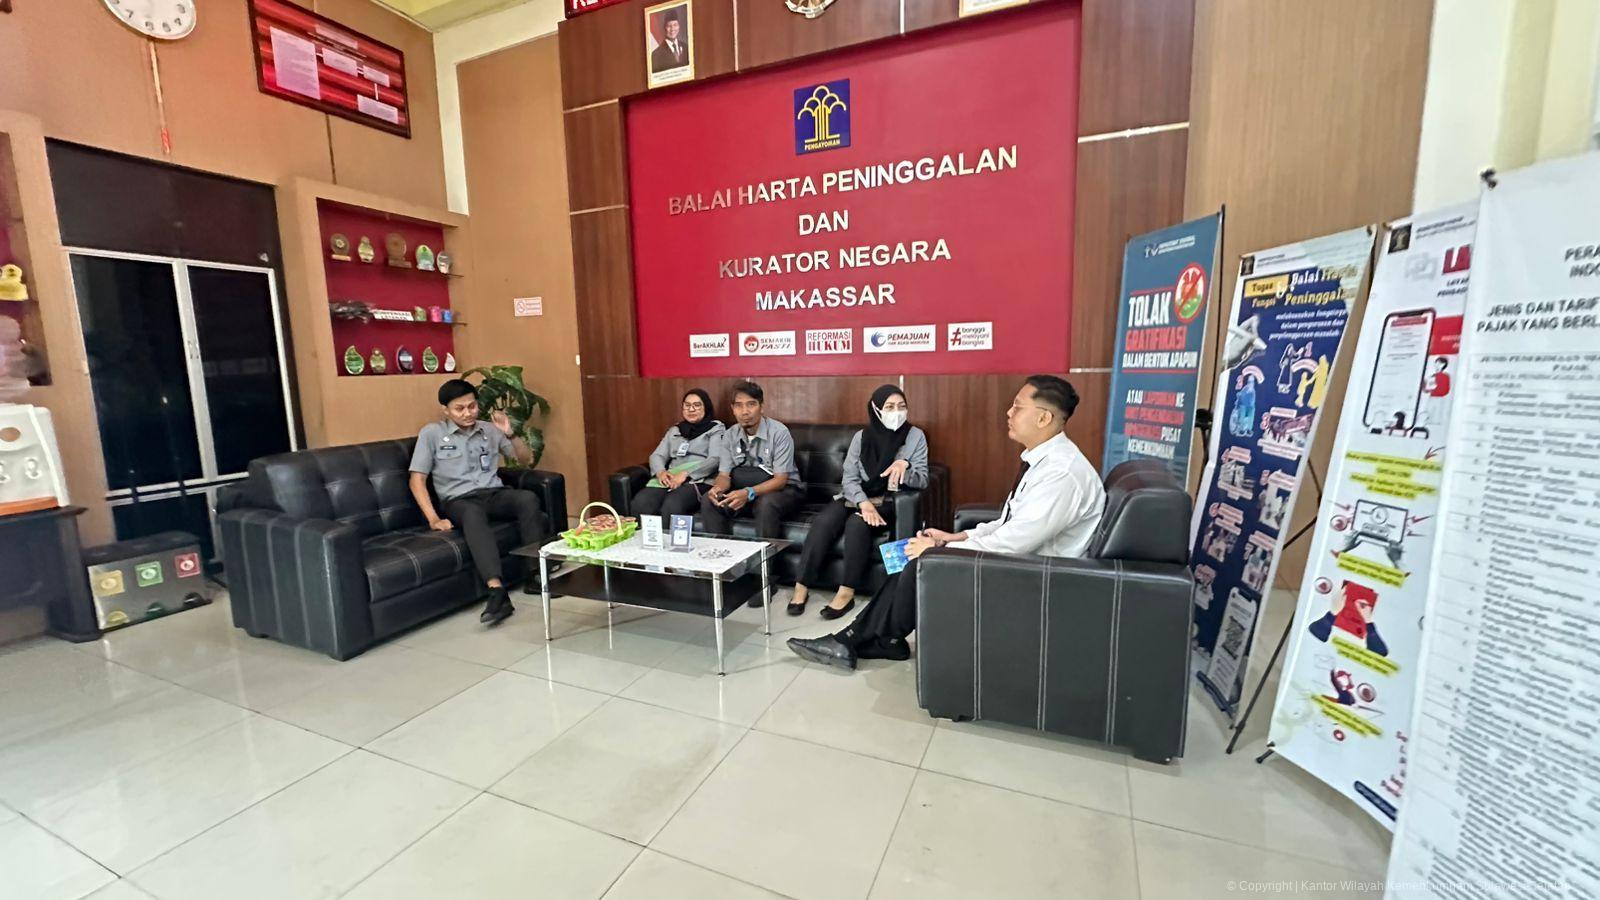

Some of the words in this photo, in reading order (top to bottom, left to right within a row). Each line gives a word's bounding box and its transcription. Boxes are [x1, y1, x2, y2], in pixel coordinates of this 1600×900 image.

[669, 188, 731, 215] BALAI
[738, 176, 817, 206] HARTA
[823, 145, 1018, 195] PENINGGALAN
[799, 209, 849, 236] DAN
[719, 250, 829, 279] KURATOR
[839, 238, 951, 269] NEGARA
[1291, 267, 1320, 285] Balai
[1252, 282, 1273, 292] Tugas
[755, 283, 896, 311] MAKASSAR
[1252, 297, 1276, 309] Fungsi
[1128, 291, 1171, 327] TOLAK
[1487, 302, 1522, 317] JENIS
[1526, 301, 1555, 315] DAN
[1559, 296, 1600, 312] TARIF
[1476, 319, 1517, 332] PAJAK
[1520, 316, 1559, 331] YANG
[808, 331, 850, 341] REFORMASI
[887, 332, 930, 341] PEMAJUAN
[1125, 325, 1187, 352] GRATIFIKASI
[808, 340, 850, 351] HUKUM
[1143, 352, 1169, 368] BENTUK
[1126, 389, 1143, 404] ATAU
